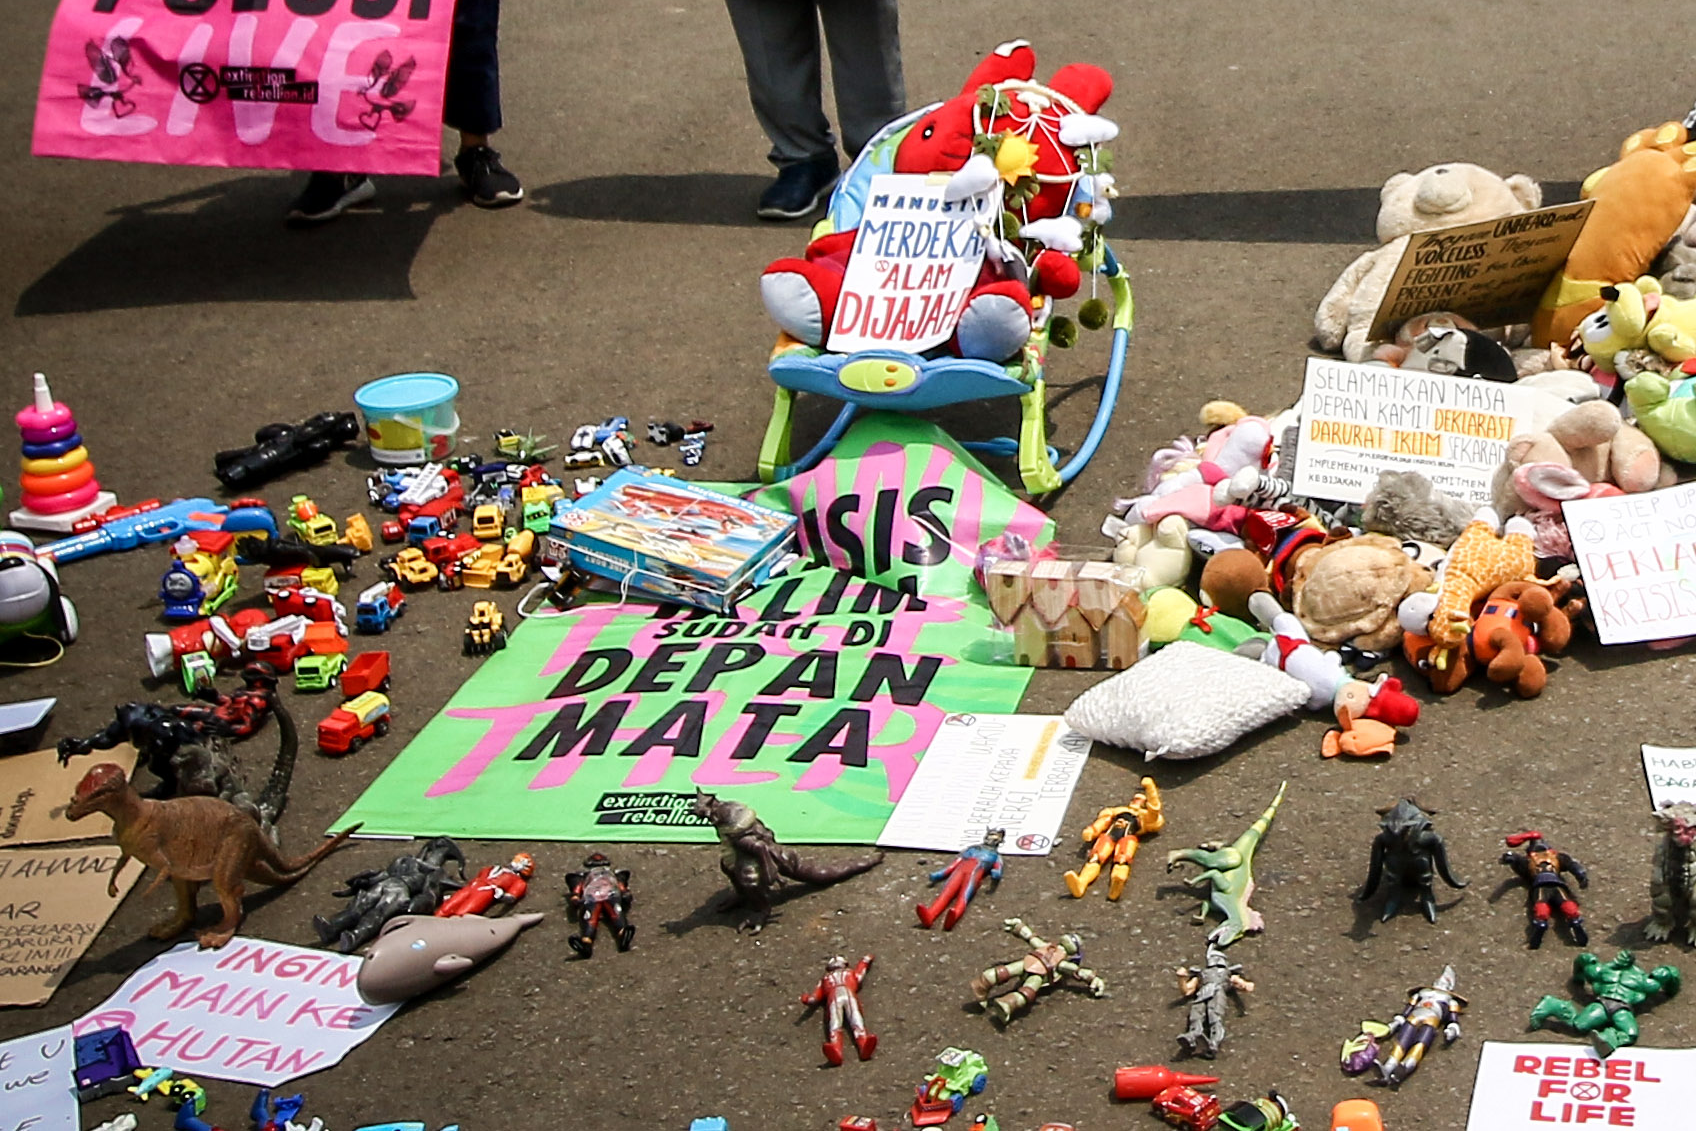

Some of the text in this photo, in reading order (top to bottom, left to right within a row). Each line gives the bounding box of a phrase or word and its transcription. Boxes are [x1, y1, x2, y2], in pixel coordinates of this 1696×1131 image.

[856, 219, 984, 259] MERDEKA!
[1493, 212, 1556, 238] UNHEARD
[880, 262, 955, 290] ALAM
[1403, 262, 1482, 286] FIGHTING
[1314, 366, 1506, 413] SELAMATKAN MASA
[1313, 394, 1368, 420] DEPAN
[1434, 408, 1513, 442] DEKLARASI
[1311, 420, 1384, 448] DARURAT
[1449, 436, 1506, 466] SEKARAN
[1608, 488, 1696, 520] STEP UP
[1615, 522, 1652, 541] ACT
[652, 619, 894, 649] SUDAH DI
[545, 642, 944, 707] DEPAN
[513, 699, 871, 768] MATA
[216, 945, 359, 988] INGIN
[130, 970, 373, 1030] MAIN KE
[134, 1020, 324, 1073] HUTAN
[1513, 1055, 1661, 1083] REBEL
[1530, 1100, 1636, 1127] LIFE
